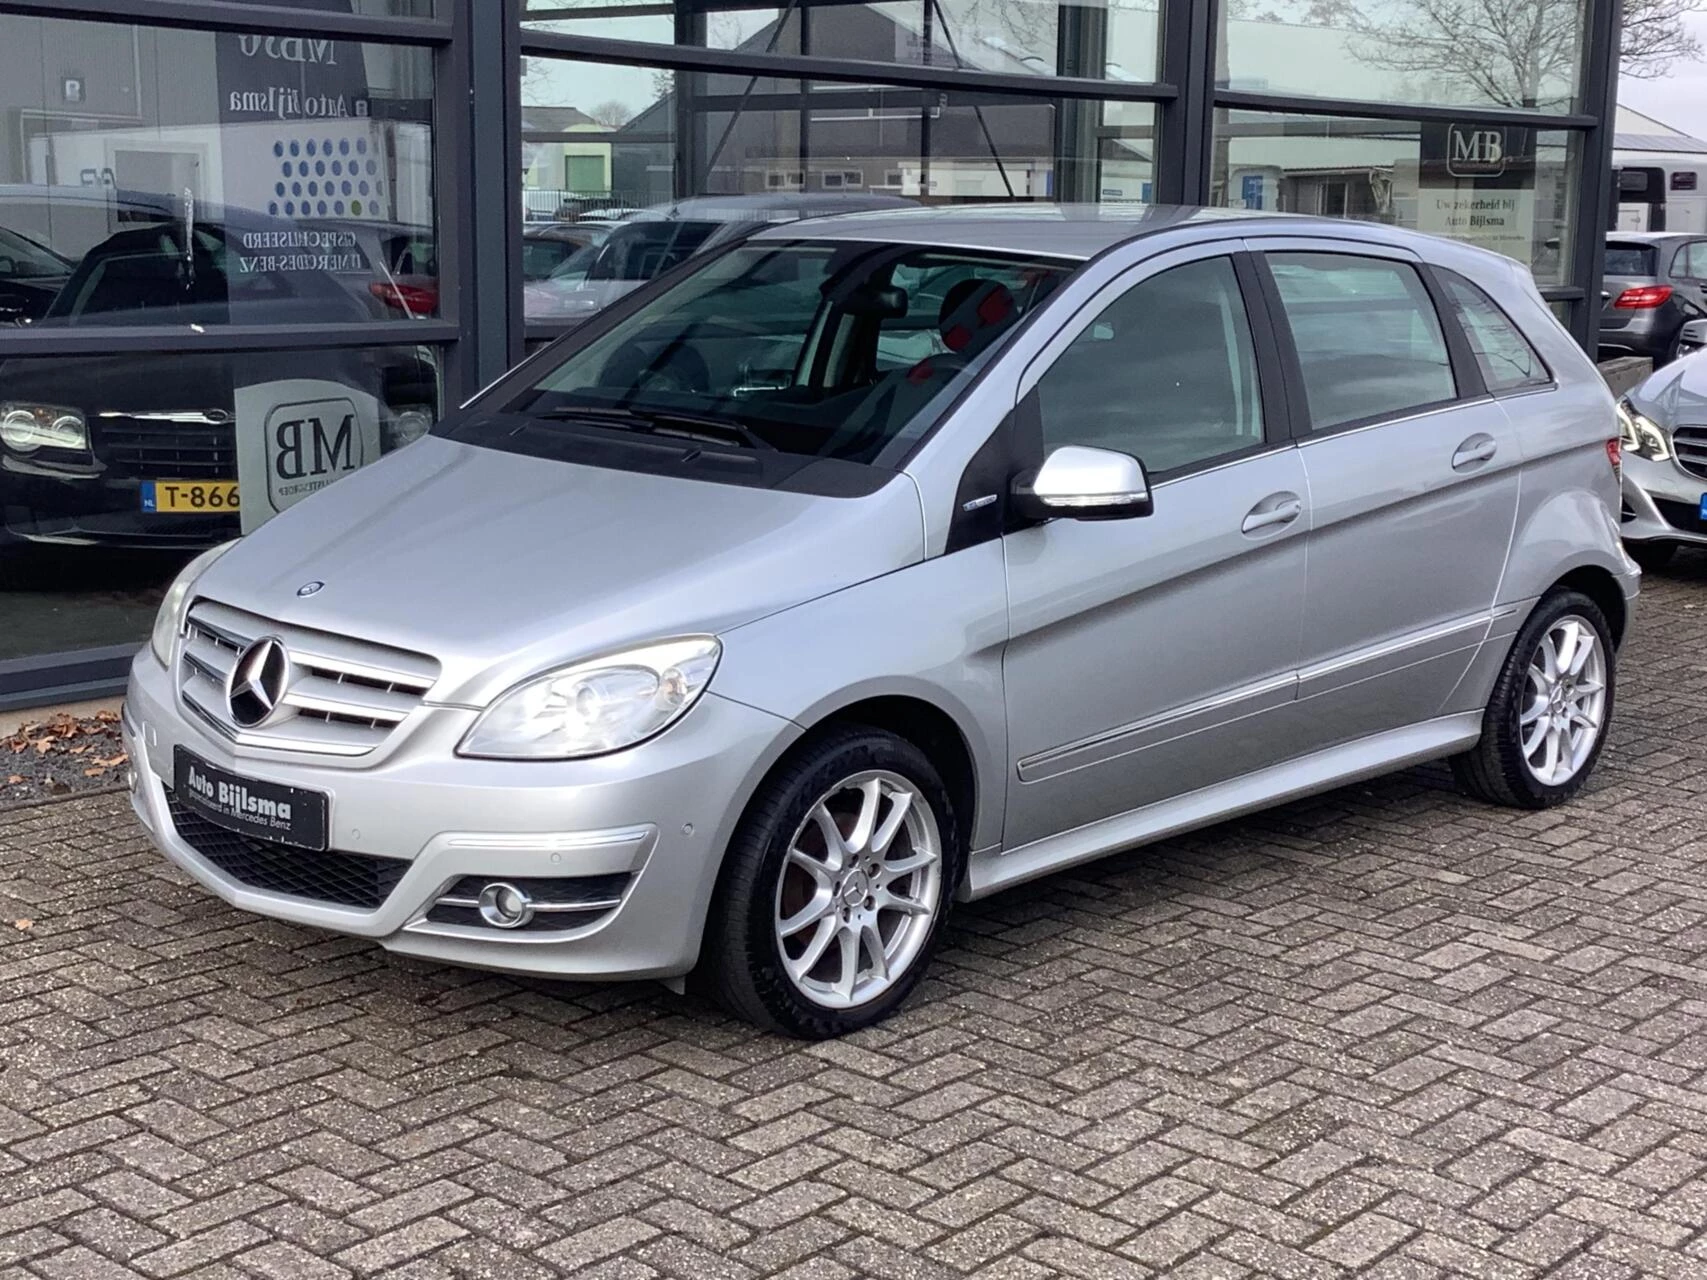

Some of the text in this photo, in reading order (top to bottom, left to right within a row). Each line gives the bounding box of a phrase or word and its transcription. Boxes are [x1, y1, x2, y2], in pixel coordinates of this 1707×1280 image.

[1452, 130, 1502, 162] MB
[1444, 215, 1504, 228] Auto Bijlsma
[188, 765, 214, 798] Auto
[218, 781, 291, 820] Bijlsma
[231, 807, 268, 827] Mercedes
[270, 816, 291, 831] Benz
